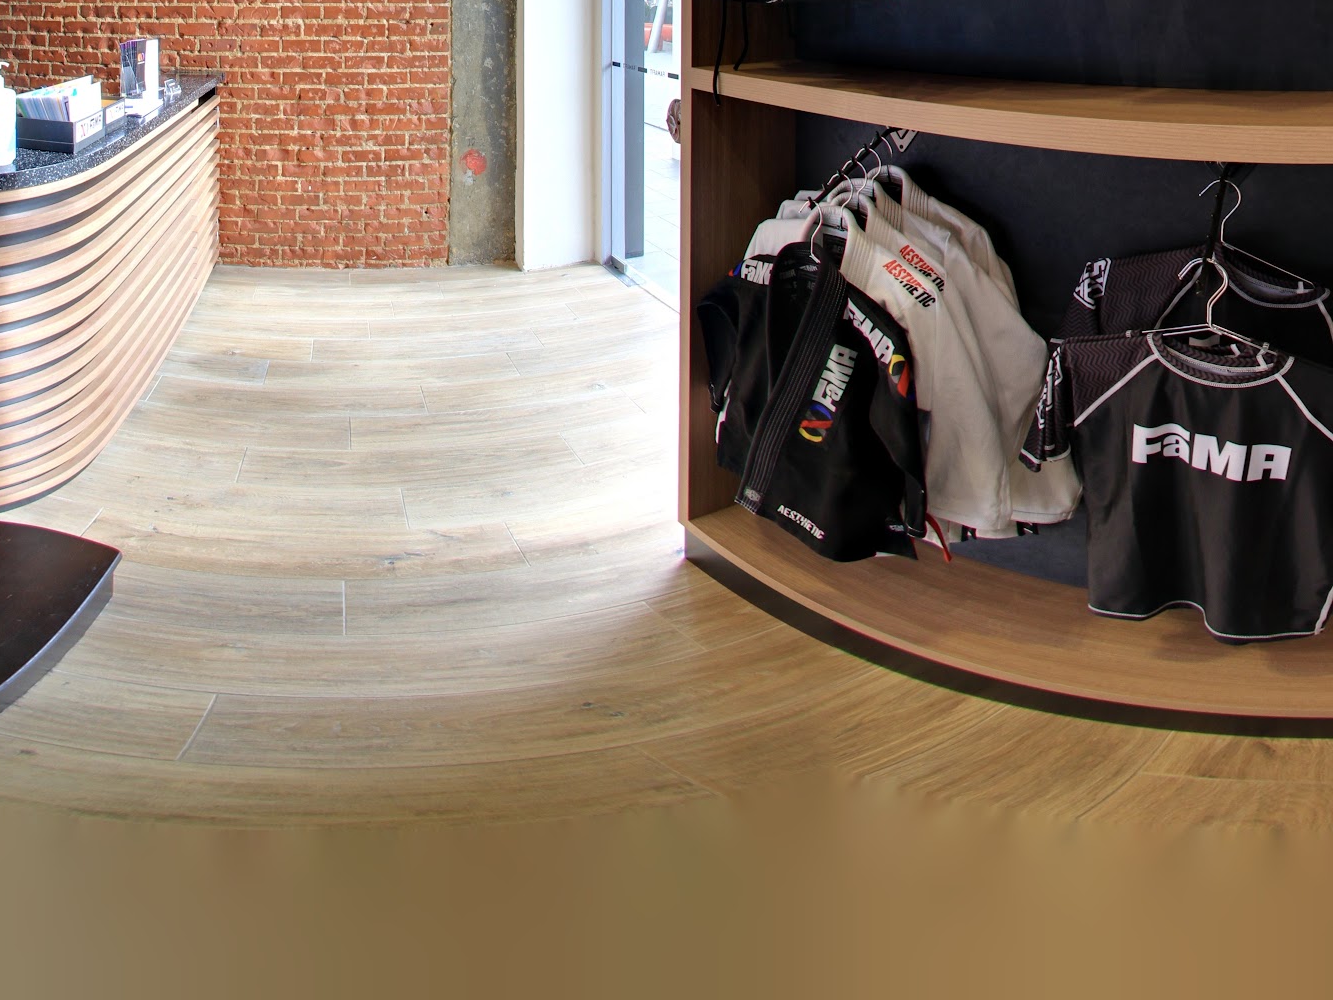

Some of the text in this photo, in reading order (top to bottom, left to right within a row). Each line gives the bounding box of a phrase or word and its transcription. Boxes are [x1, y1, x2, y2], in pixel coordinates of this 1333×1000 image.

[812, 344, 858, 412] FaMA
[1132, 423, 1292, 482] FaMA
[777, 504, 826, 540] AESTHETIC
